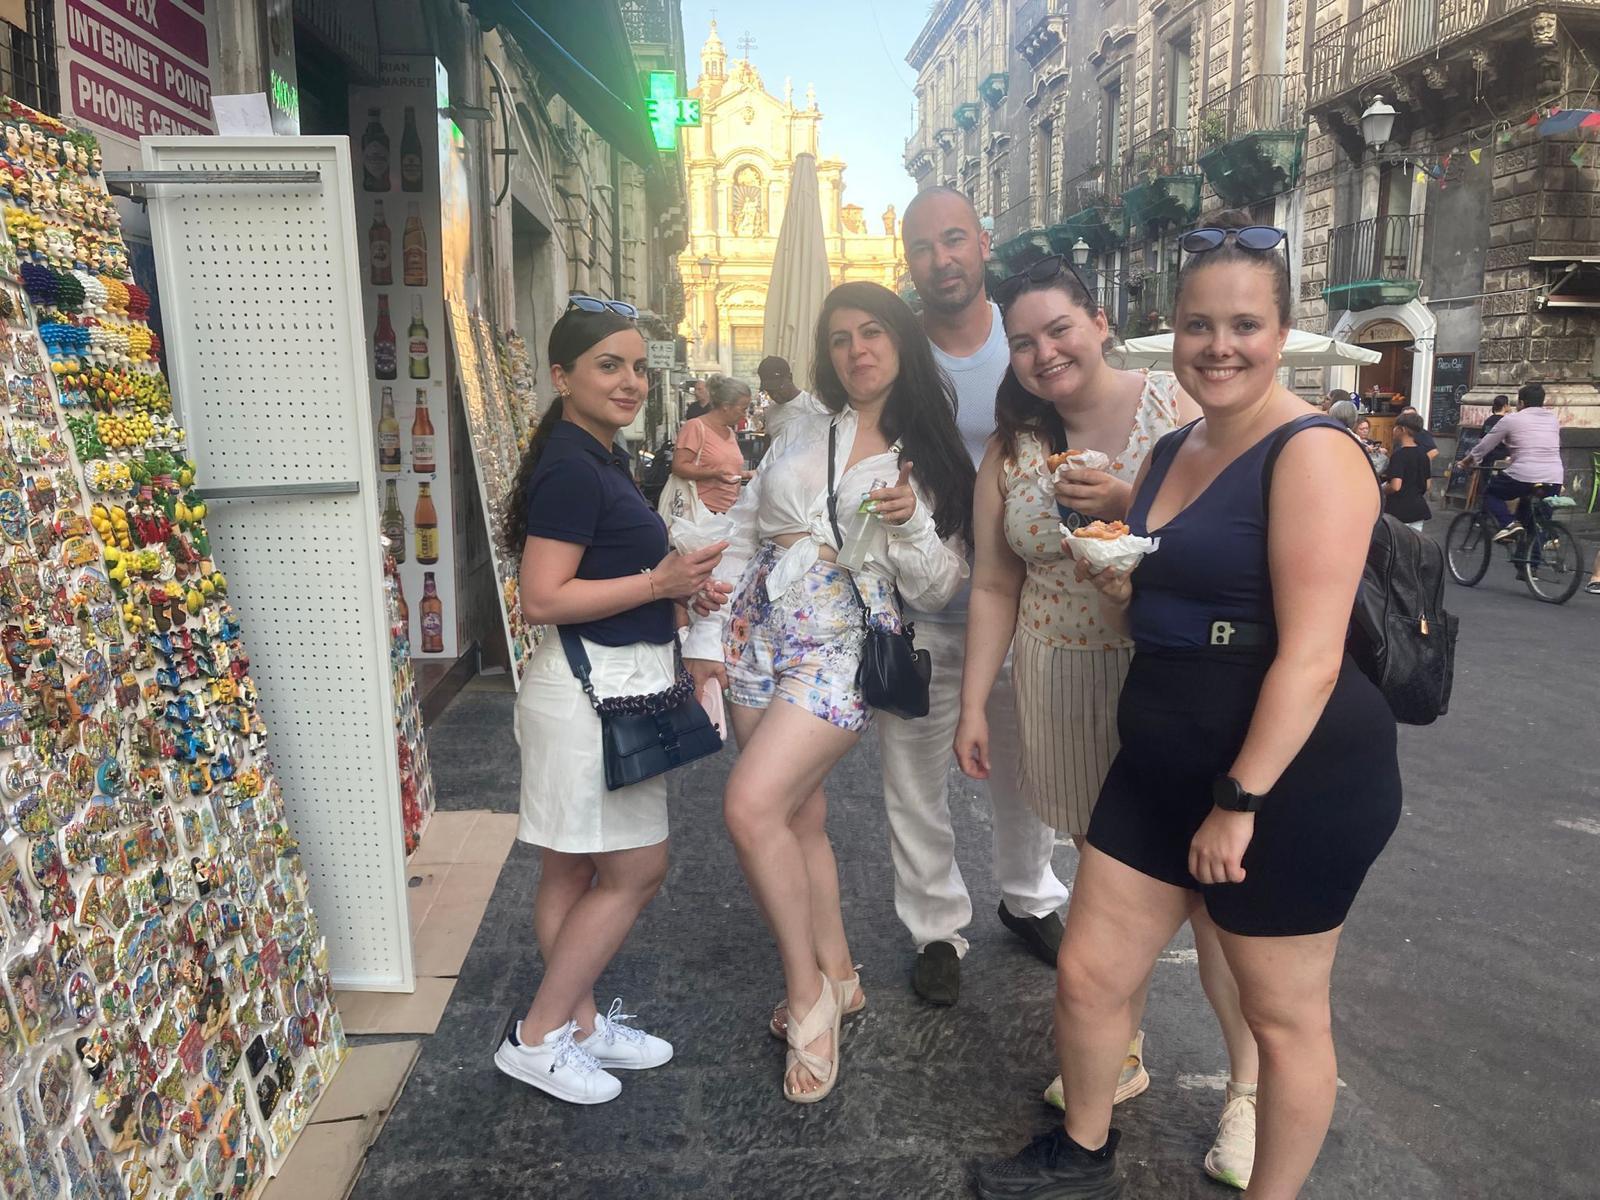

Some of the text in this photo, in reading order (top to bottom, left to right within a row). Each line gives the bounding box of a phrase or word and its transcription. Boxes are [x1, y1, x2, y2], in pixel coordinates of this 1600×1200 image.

[68, 5, 159, 84] INTERNET
[164, 61, 209, 111] POINT
[78, 74, 146, 134] PHONE
